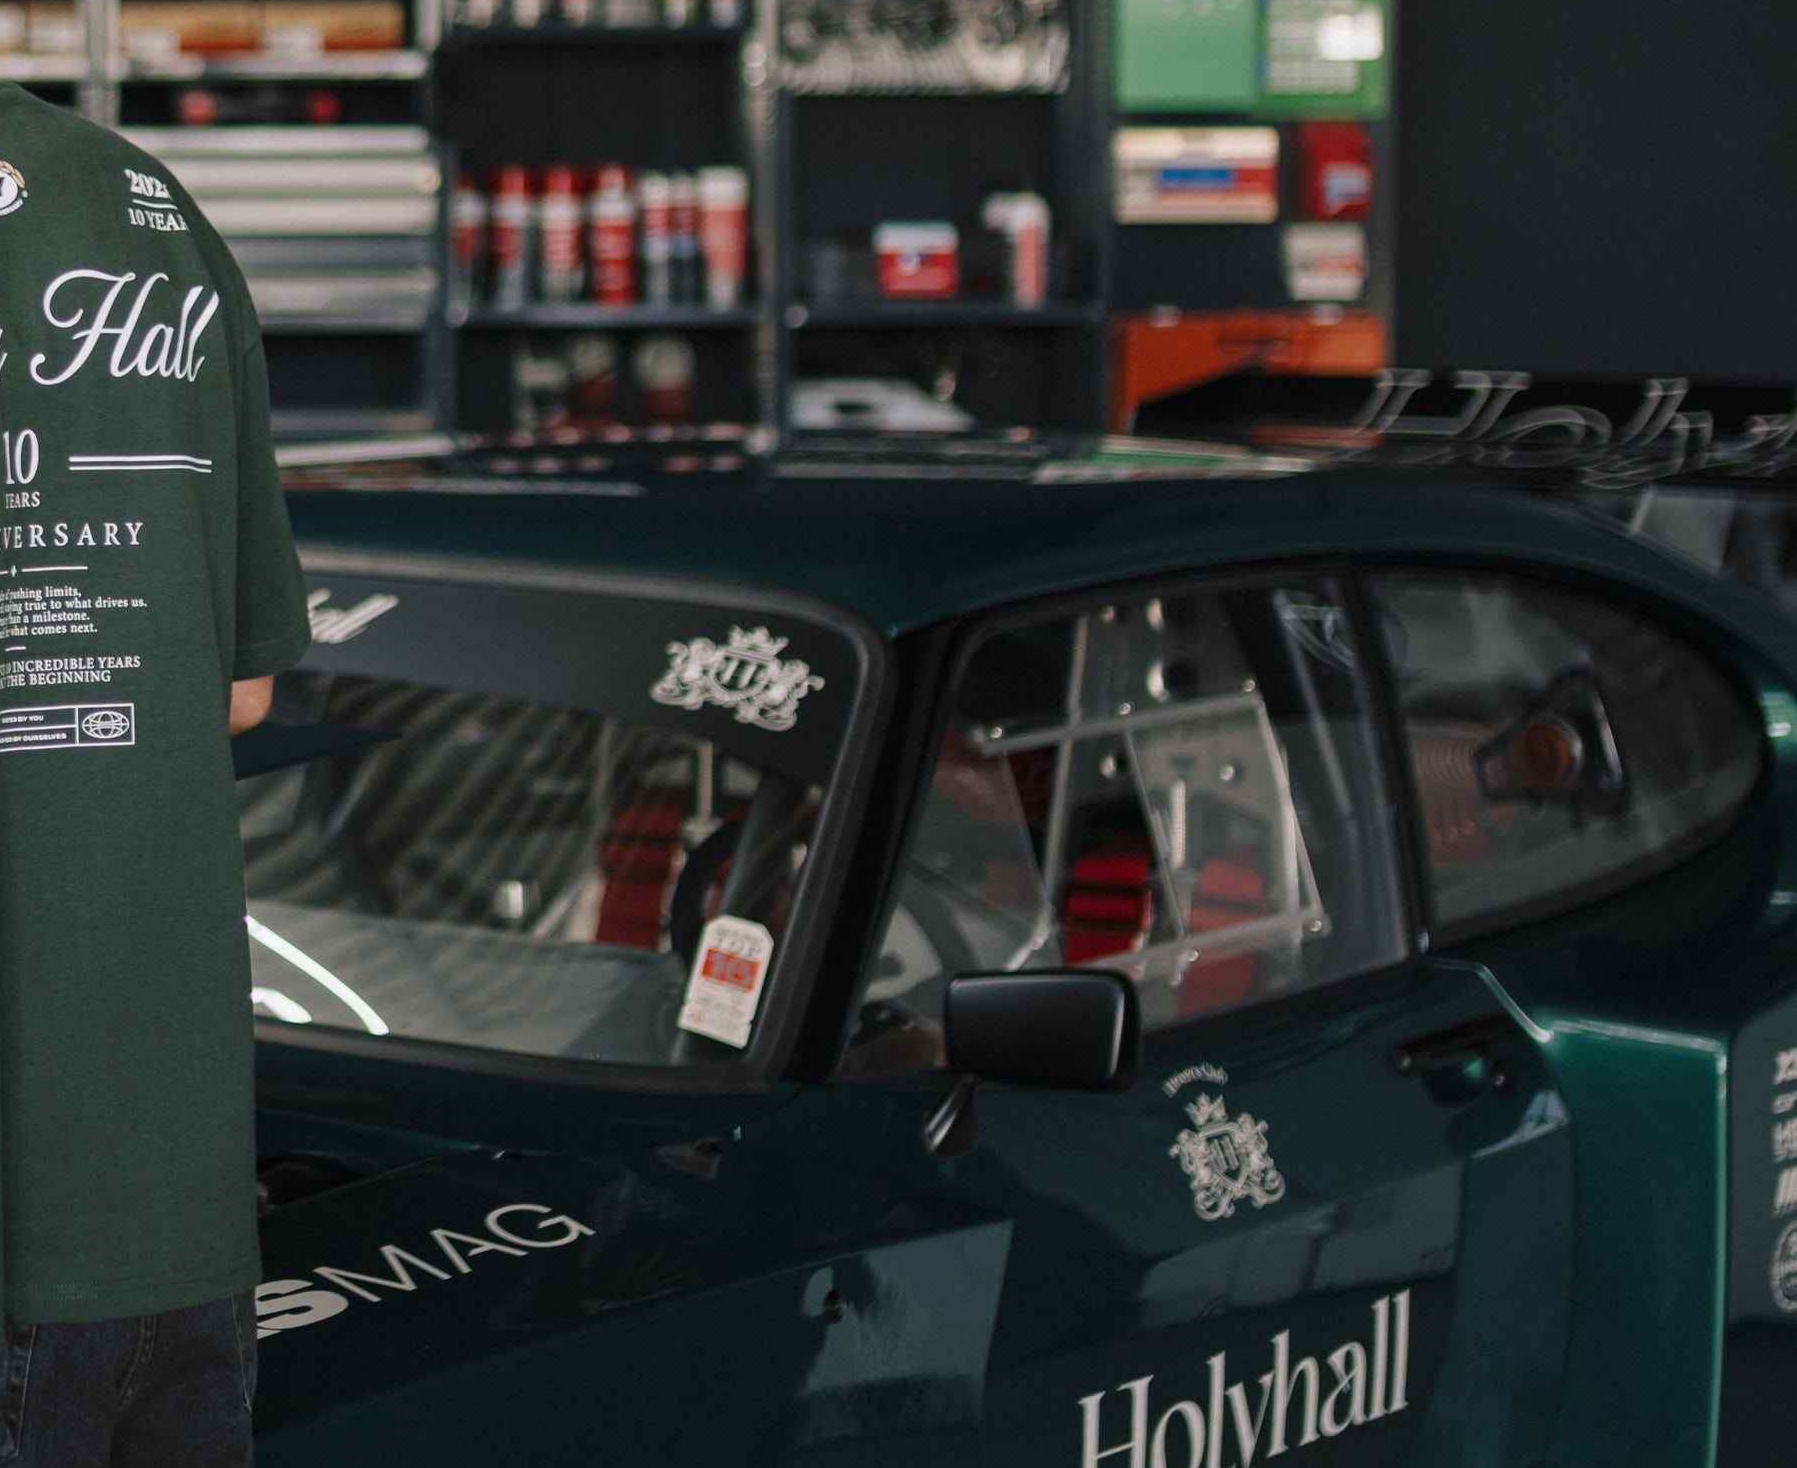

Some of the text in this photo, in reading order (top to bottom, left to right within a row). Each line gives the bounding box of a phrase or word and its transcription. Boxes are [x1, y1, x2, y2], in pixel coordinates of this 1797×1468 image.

[124, 168, 173, 201] 202
[127, 207, 146, 226] 10
[29, 269, 220, 386] Hall
[2, 429, 39, 484] 10
[45, 586, 81, 598] limits,
[25, 601, 47, 612] true
[50, 599, 62, 609] to
[65, 598, 92, 609] what
[95, 596, 128, 608] drives
[131, 597, 147, 608] us.
[32, 611, 90, 623] milestone.
[31, 623, 67, 635] comes
[70, 622, 98, 633] next.
[12, 657, 94, 673] INCREDIBLE
[98, 655, 141, 669] YEARS
[29, 670, 111, 686] BEGINNING
